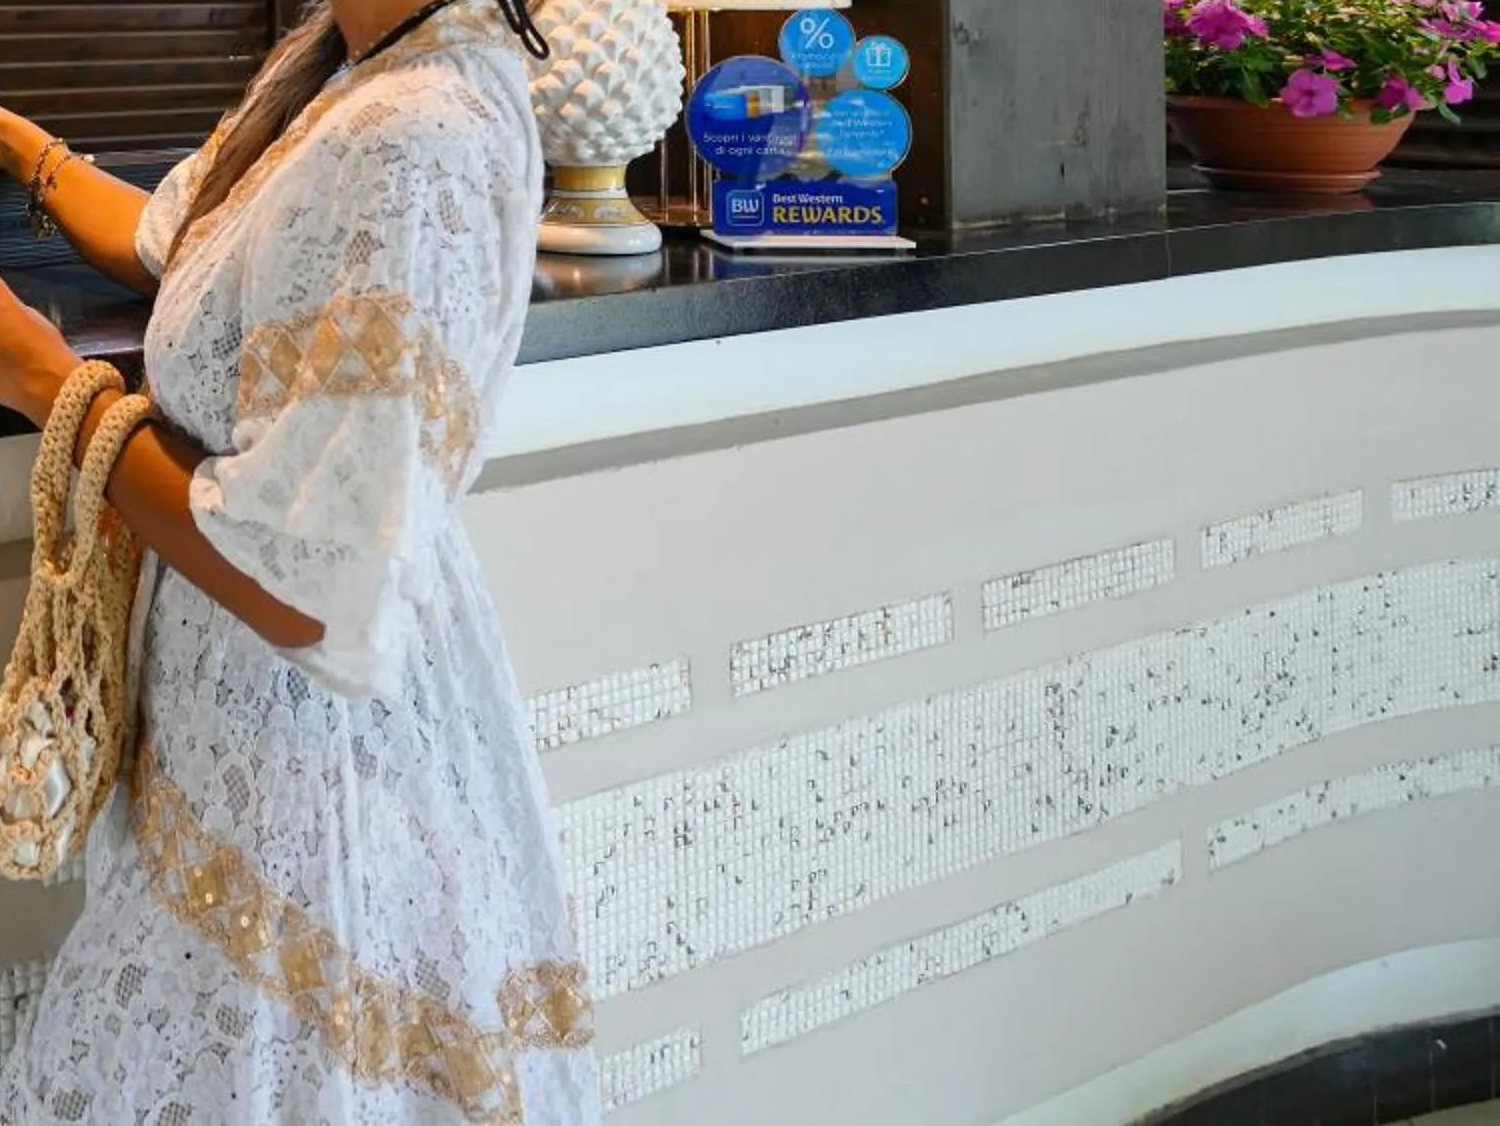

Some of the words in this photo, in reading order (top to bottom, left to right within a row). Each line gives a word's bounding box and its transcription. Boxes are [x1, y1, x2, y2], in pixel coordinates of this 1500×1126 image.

[731, 198, 760, 213] BW
[773, 193, 797, 204] Best
[798, 193, 844, 204] Western
[772, 205, 883, 224] REWARDS
